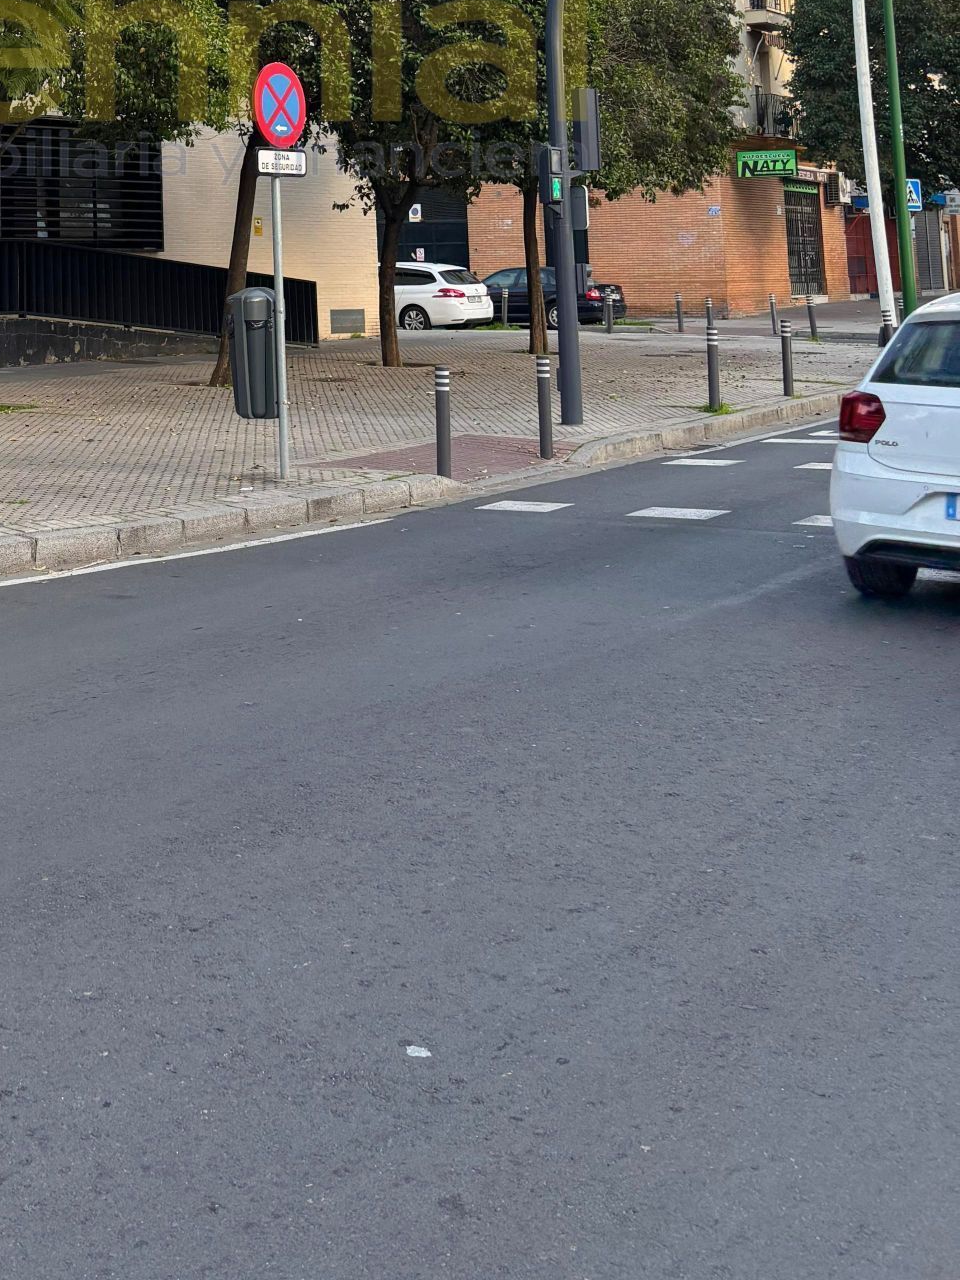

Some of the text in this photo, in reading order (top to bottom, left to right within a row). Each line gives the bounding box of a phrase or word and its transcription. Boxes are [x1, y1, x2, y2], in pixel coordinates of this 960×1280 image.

[274, 152, 290, 161] ZONA
[261, 162, 303, 172] DE SEGURIDAD
[741, 159, 791, 177] NATY
[875, 439, 899, 447] POLO
